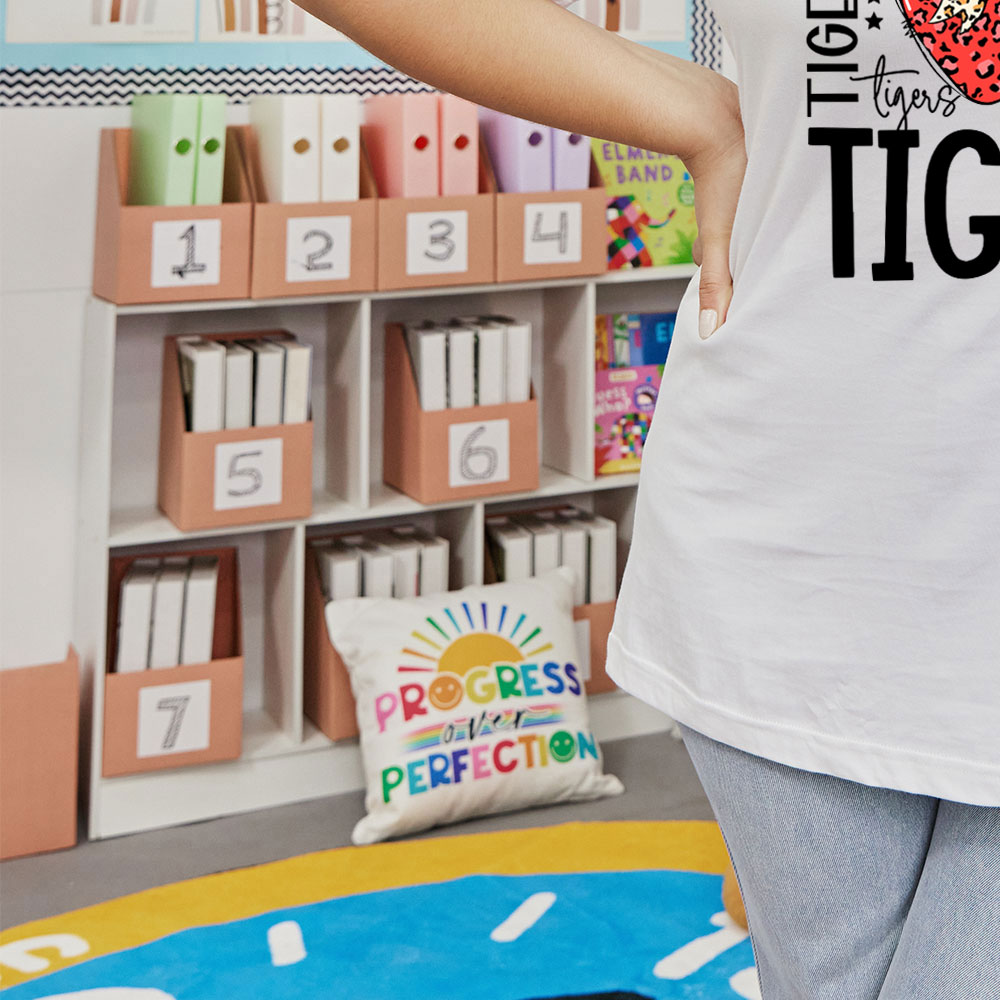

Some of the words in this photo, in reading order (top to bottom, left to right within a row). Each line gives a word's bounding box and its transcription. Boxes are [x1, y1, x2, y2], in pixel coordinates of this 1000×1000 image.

[849, 55, 961, 131] tigers
[616, 165, 673, 184] BAND
[171, 223, 207, 279] 1
[301, 229, 334, 271] 2
[424, 218, 456, 261] 3
[531, 210, 567, 254] 4
[227, 449, 263, 497] 5
[459, 426, 498, 482] 6
[156, 694, 191, 750] 7
[375, 661, 582, 734] PROGRESS
[442, 708, 527, 744] over
[381, 729, 600, 804] PERFECTION
